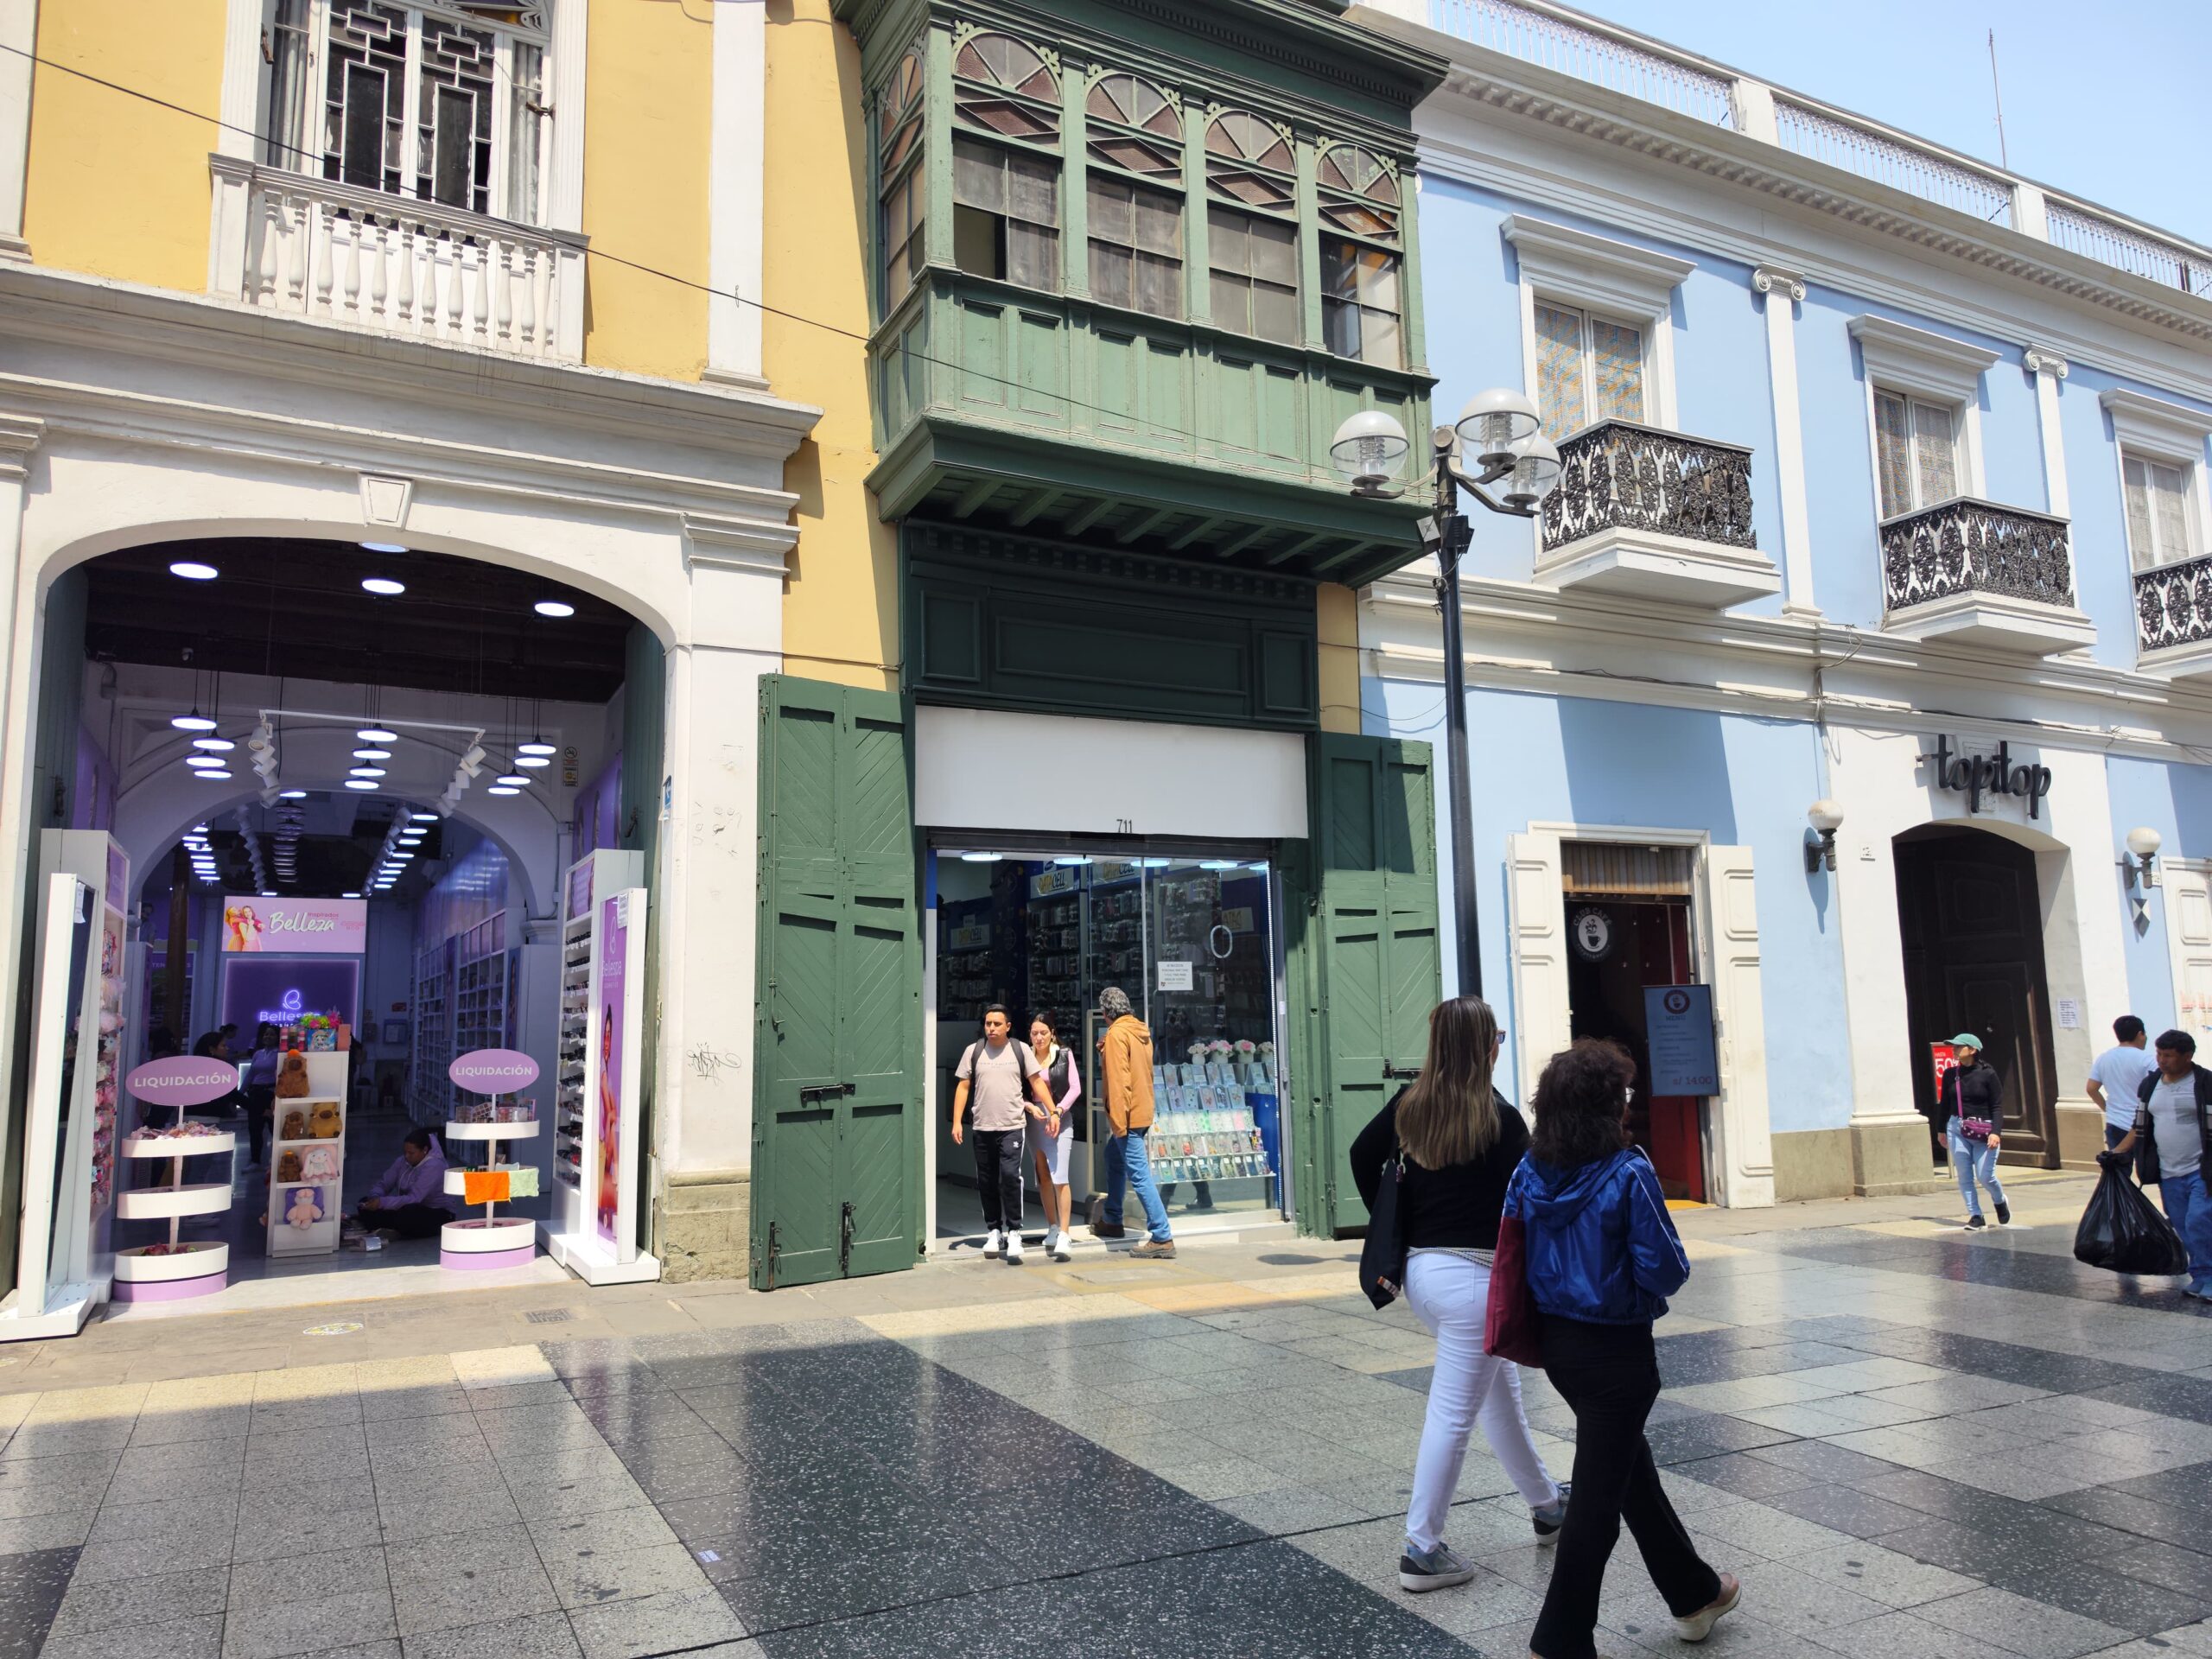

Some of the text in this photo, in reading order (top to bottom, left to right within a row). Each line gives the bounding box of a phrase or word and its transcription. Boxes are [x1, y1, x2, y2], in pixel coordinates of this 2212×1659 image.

[1116, 818, 1133, 833] 711
[268, 912, 335, 934] Belleza
[455, 1065, 532, 1077] LIQUIDACIÓN
[134, 1071, 232, 1088] LIQUIDACIÓN
